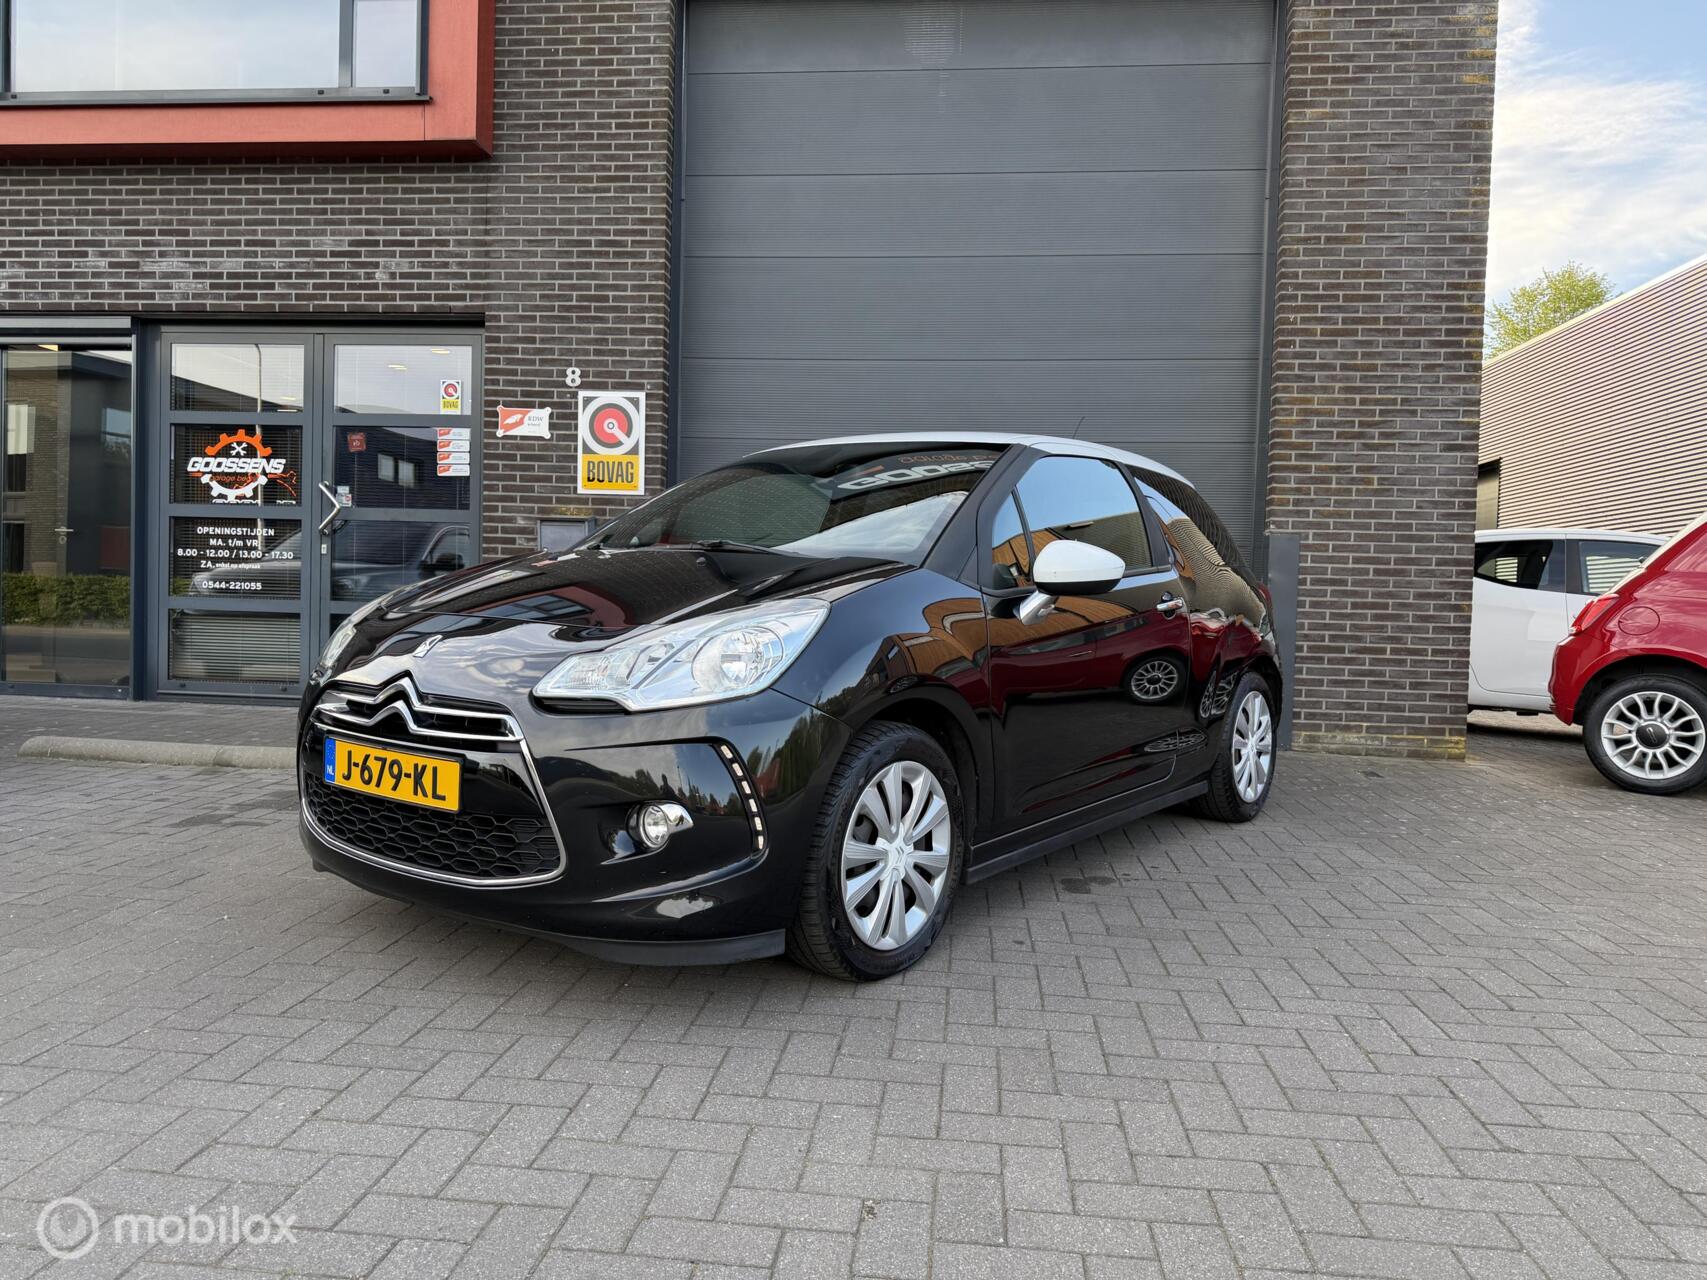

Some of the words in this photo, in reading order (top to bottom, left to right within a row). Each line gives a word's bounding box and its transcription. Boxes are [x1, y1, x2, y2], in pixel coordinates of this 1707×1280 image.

[565, 367, 582, 387] 8
[443, 400, 459, 409] BOVAG
[187, 457, 287, 473] GOOSSENS
[587, 460, 634, 483] BOVAG
[197, 526, 275, 536] OPENINGSTIJDEN
[209, 538, 226, 546] MA.
[228, 538, 243, 547] t/m
[177, 548, 198, 556] 8.00
[206, 549, 230, 557] 12.00
[239, 550, 262, 558] 13.00
[271, 551, 294, 559] 17.30
[202, 581, 262, 590] 0544-221055
[326, 764, 334, 776] NL
[342, 750, 447, 802] J-679-KL
